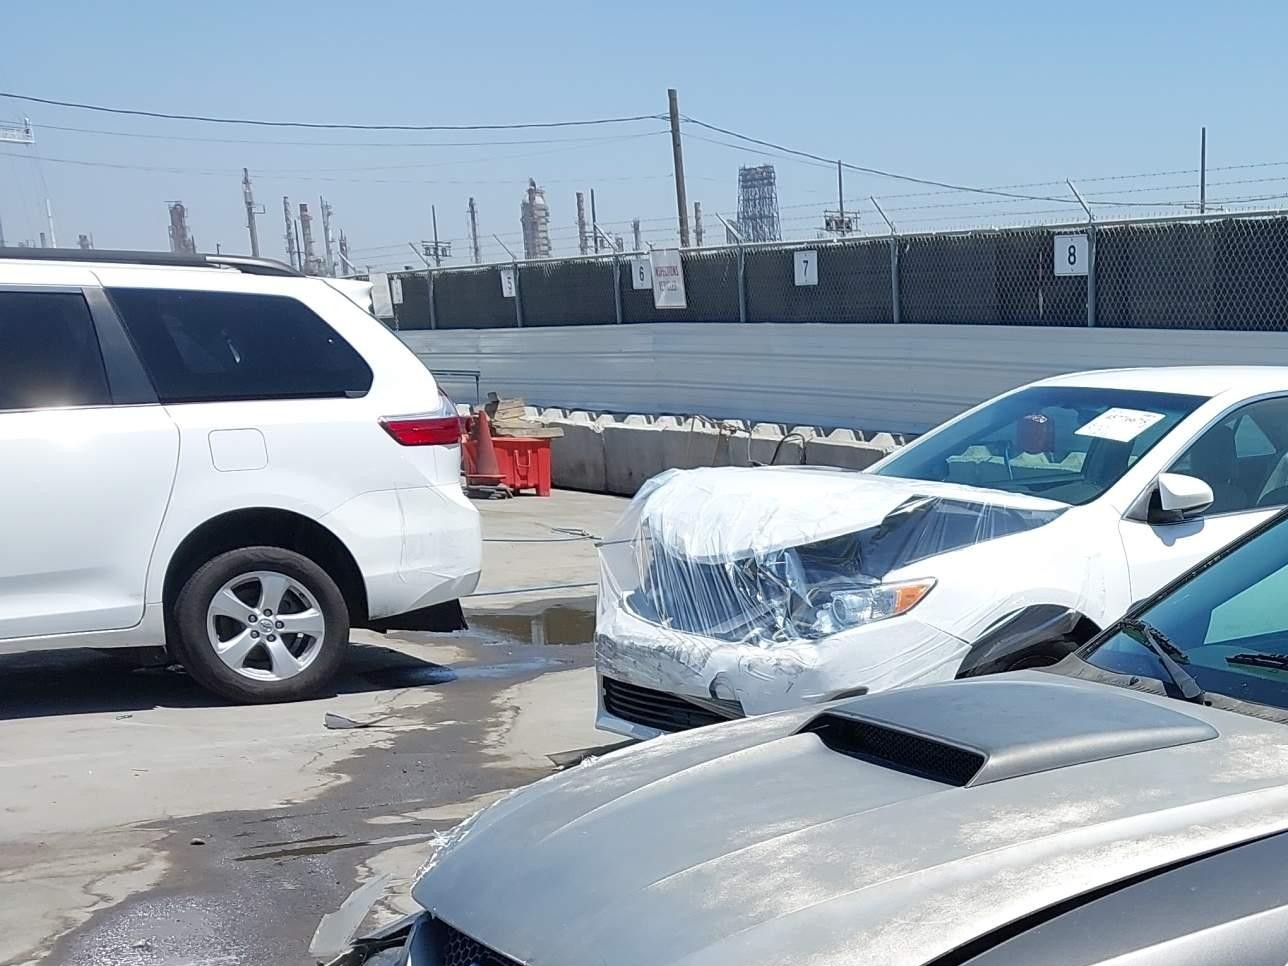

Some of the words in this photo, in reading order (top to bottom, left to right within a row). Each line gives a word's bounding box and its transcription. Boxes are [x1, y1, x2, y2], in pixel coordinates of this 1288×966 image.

[1067, 244, 1077, 266] 8
[639, 265, 645, 282] 6
[802, 259, 809, 277] 7
